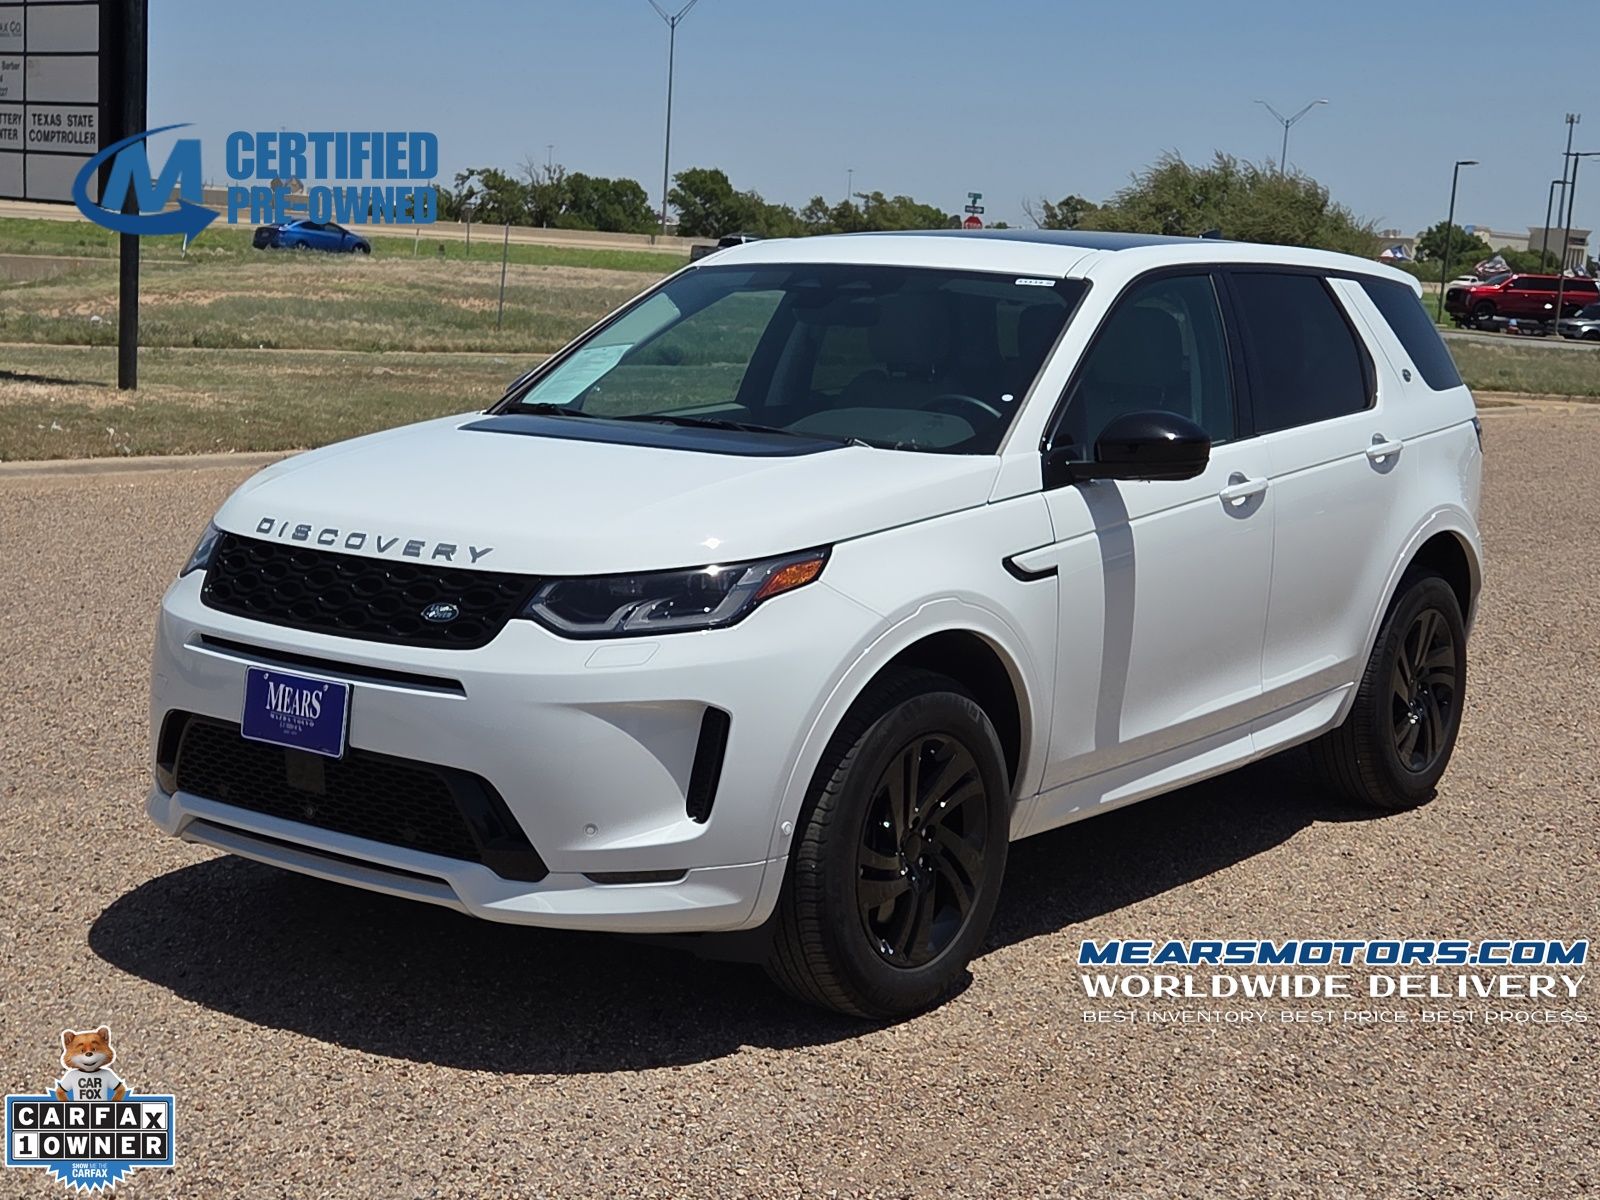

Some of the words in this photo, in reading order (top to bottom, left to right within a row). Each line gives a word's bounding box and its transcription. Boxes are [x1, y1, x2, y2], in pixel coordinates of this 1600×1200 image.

[32, 113, 62, 126] TEXAS
[67, 114, 94, 128] STATE
[29, 129, 96, 145] COMPTROLLER
[256, 517, 494, 564] DISCOVERY
[265, 681, 323, 719] MEARS
